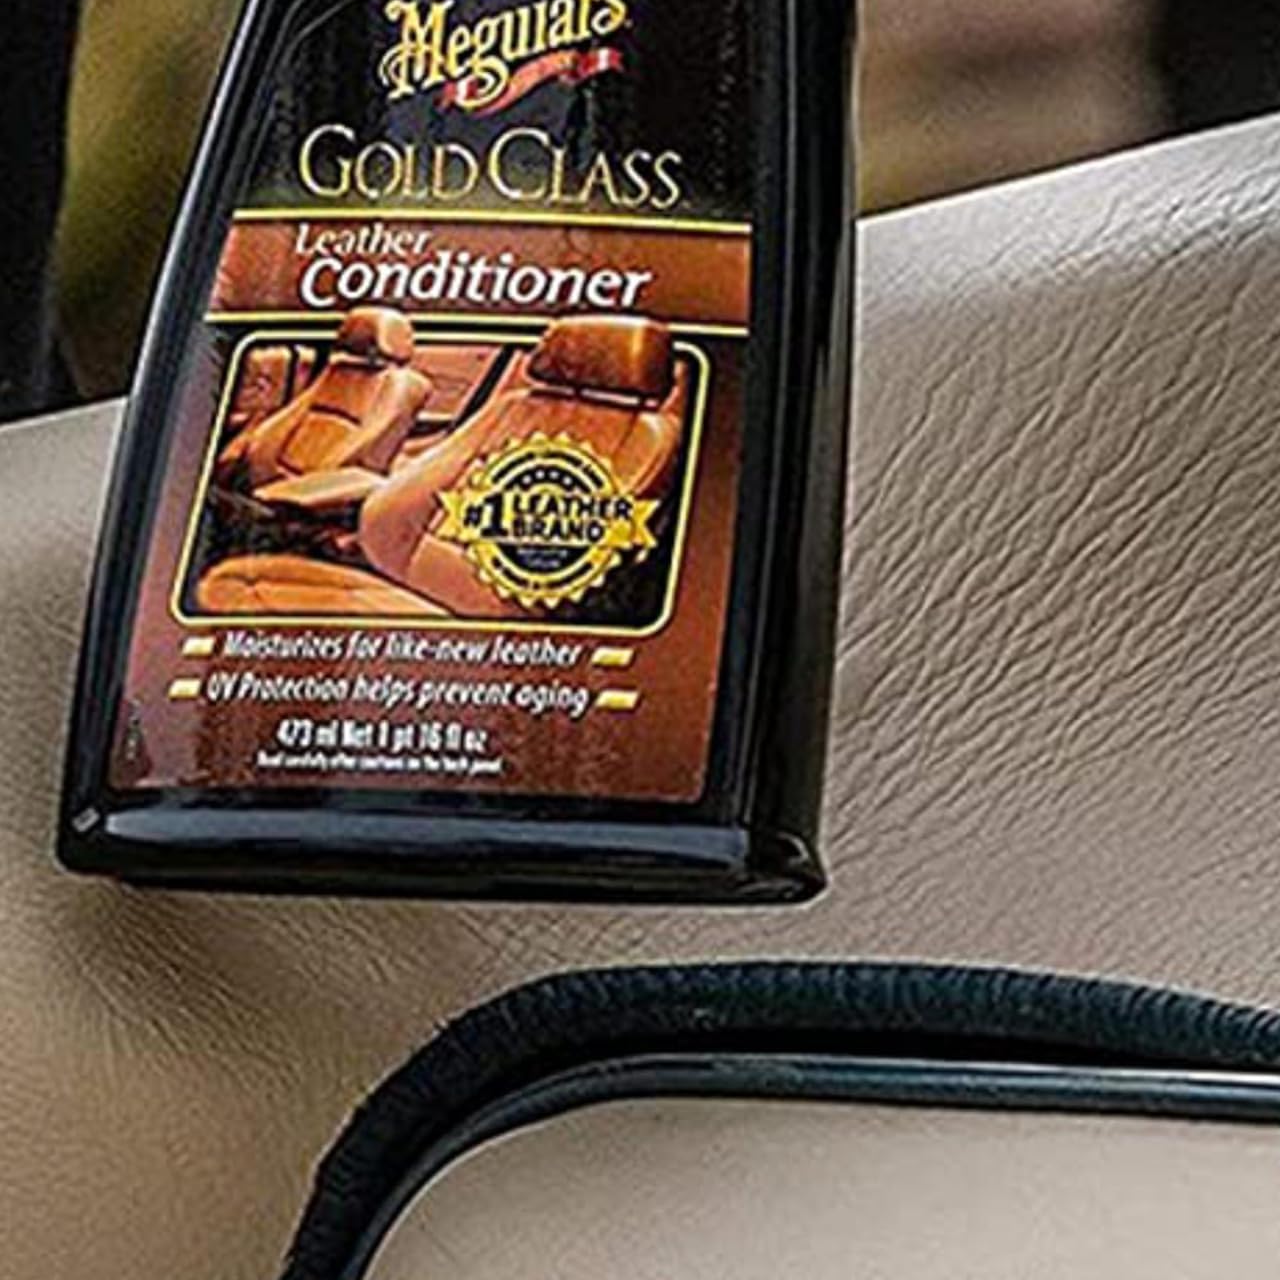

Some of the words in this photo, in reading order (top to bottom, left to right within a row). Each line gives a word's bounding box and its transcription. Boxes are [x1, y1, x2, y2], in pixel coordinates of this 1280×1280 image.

[299, 123, 480, 199] GOLD
[487, 126, 684, 209] CLASS
[295, 222, 434, 256] Leather
[300, 249, 653, 308] Conditioner
[463, 492, 509, 538] #1
[513, 493, 633, 520] LEATHER
[512, 516, 606, 543] BRAND
[222, 630, 344, 659] Moisturizes
[345, 630, 383, 662] for
[385, 630, 490, 663] like-new
[490, 634, 584, 666] leather
[206, 672, 239, 702] UV
[237, 672, 349, 703] Protection
[351, 673, 414, 709] helps
[415, 680, 515, 711] prevent
[514, 677, 590, 719] aging
